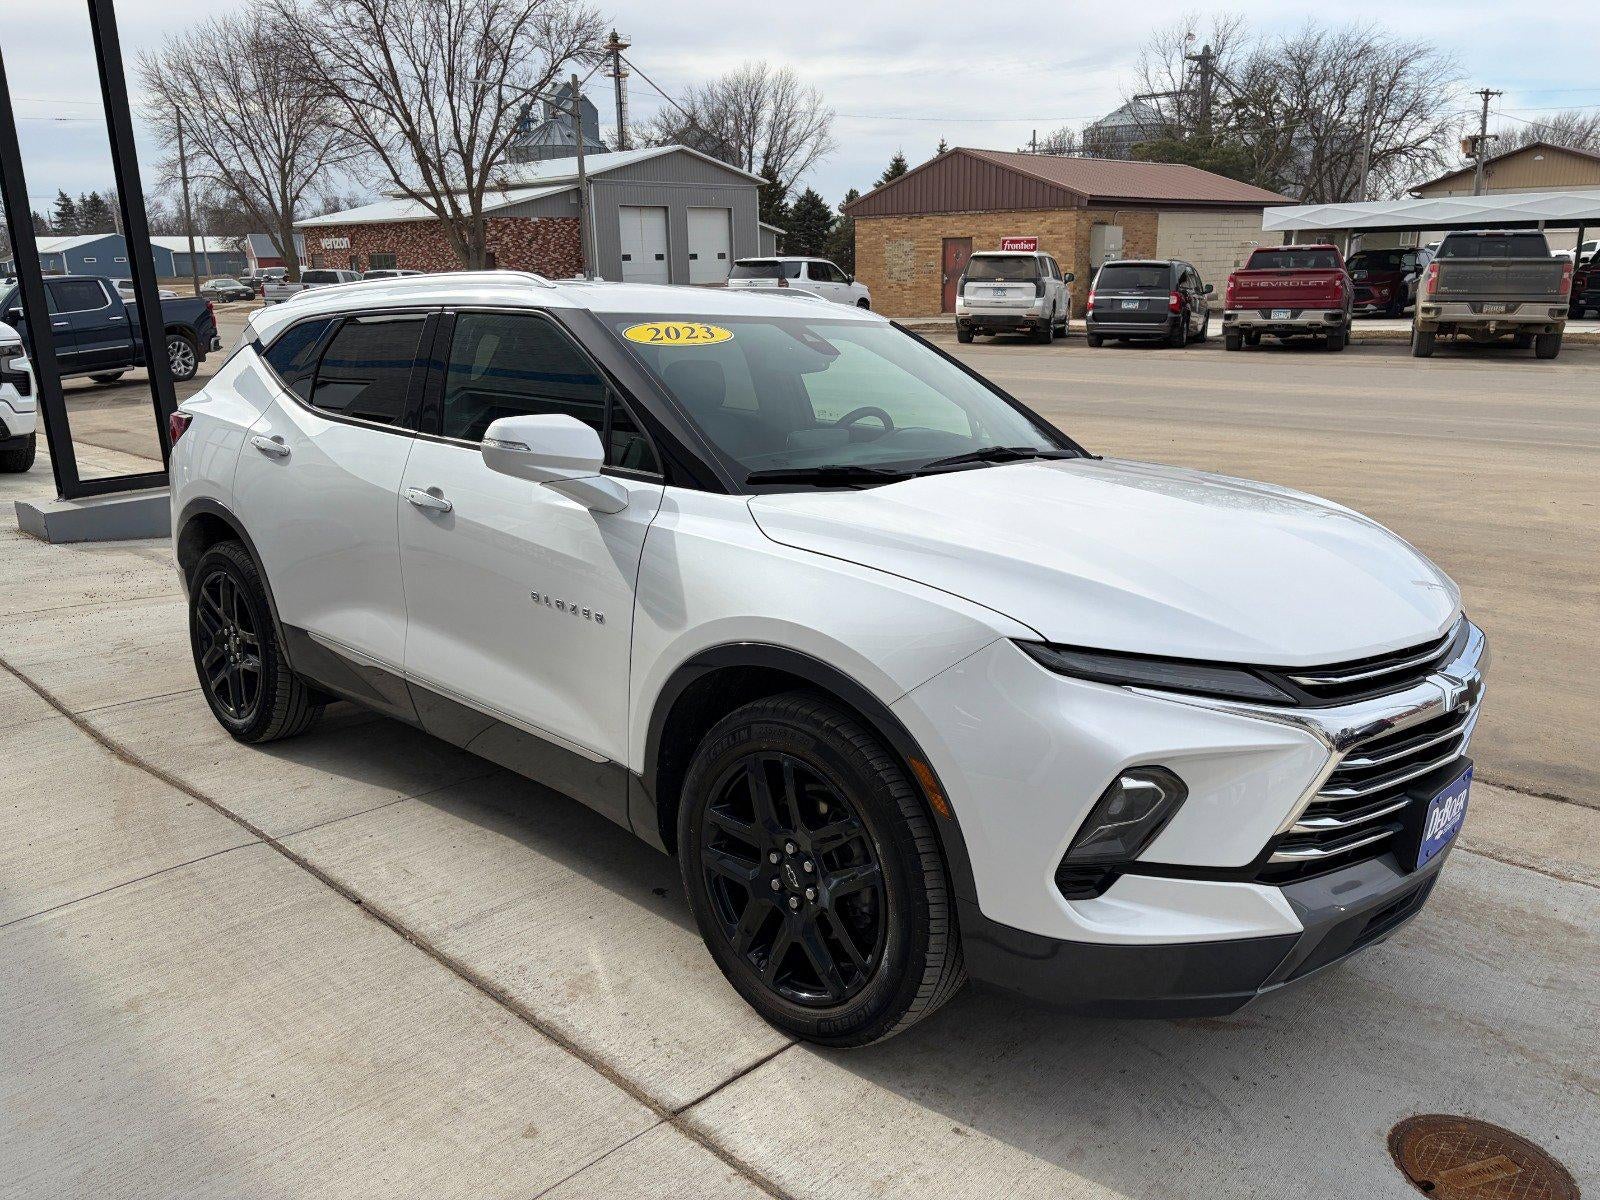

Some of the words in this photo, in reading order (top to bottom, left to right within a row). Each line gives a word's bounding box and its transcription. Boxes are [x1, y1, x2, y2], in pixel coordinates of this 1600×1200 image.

[320, 237, 351, 249] verizon
[1004, 240, 1035, 250] frontier
[646, 326, 715, 341] 2023
[530, 590, 606, 625] BLAZER
